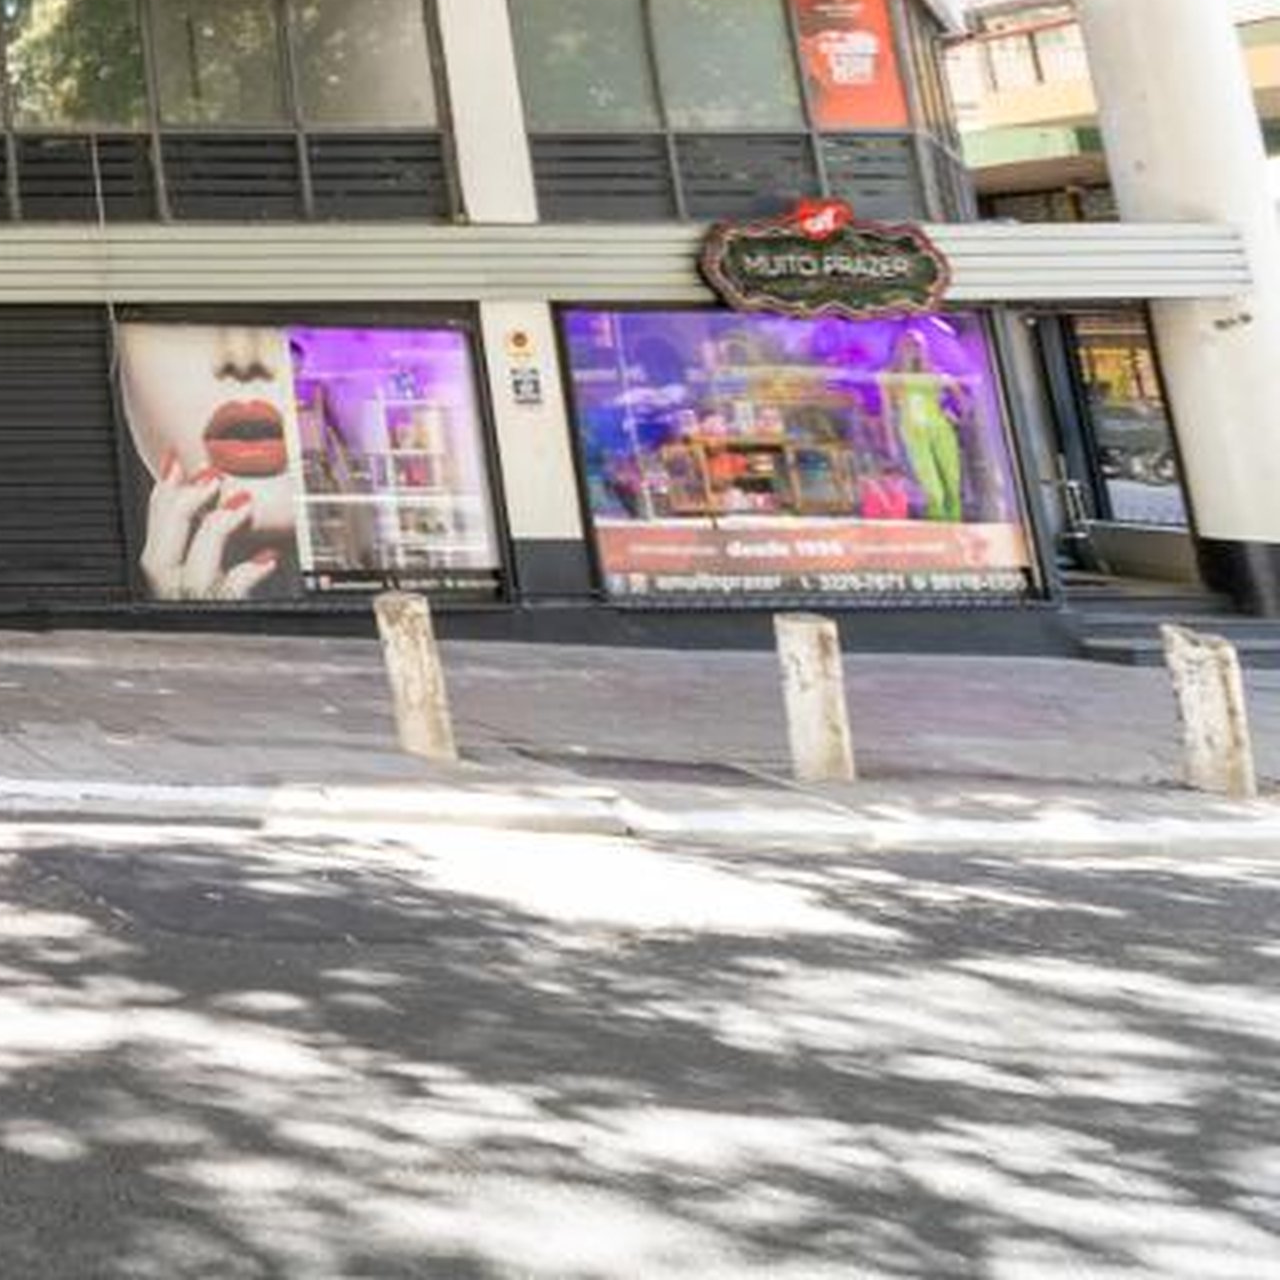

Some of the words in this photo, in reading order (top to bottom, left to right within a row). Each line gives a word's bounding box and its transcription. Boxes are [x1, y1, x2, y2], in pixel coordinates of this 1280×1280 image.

[742, 254, 818, 276] MUITO
[822, 253, 910, 278] PRAZER
[725, 540, 789, 558] desde
